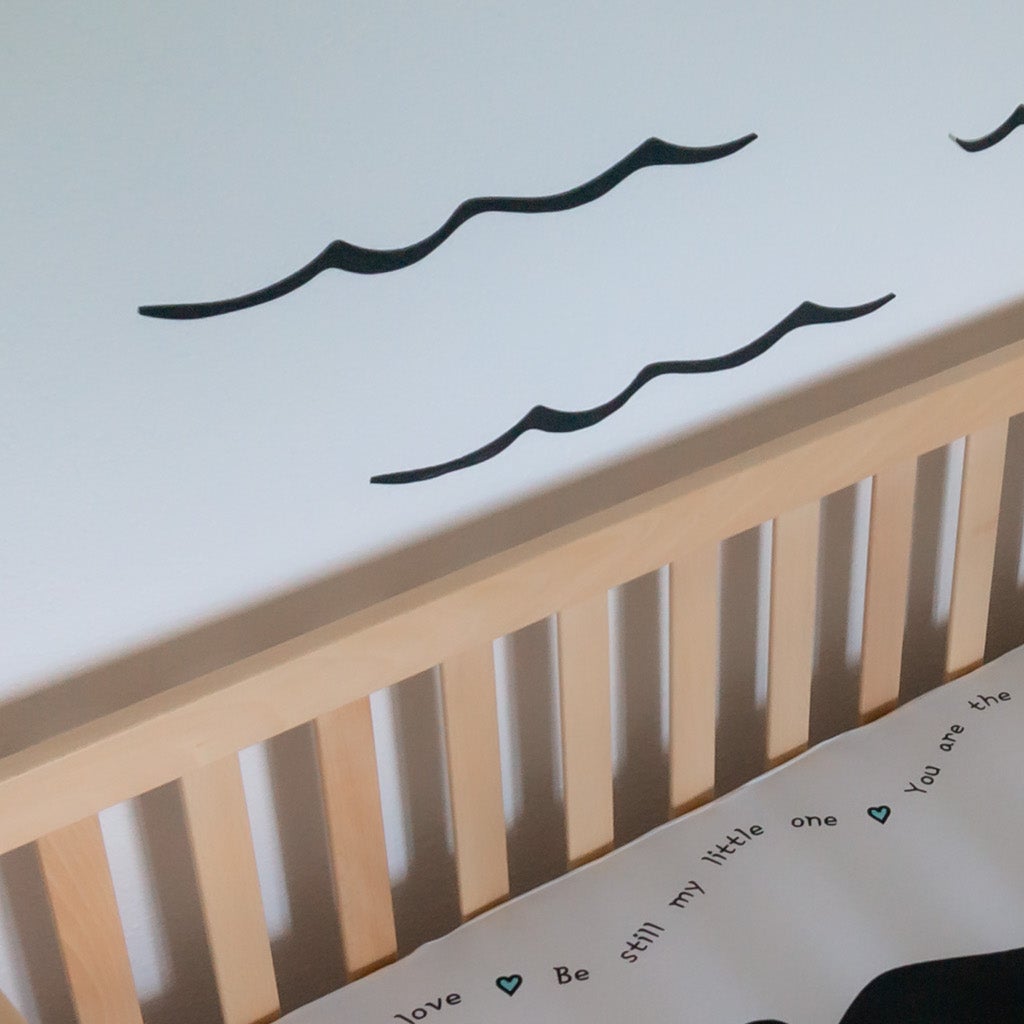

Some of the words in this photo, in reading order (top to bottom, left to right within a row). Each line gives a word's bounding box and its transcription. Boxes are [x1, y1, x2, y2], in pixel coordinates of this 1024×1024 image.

[552, 965, 590, 986] Be
[620, 921, 665, 964] still
[668, 880, 706, 909] my
[700, 824, 765, 866] little
[790, 815, 838, 828] one
[903, 765, 941, 794] You
[939, 724, 965, 753] are
[967, 691, 1012, 711] the
